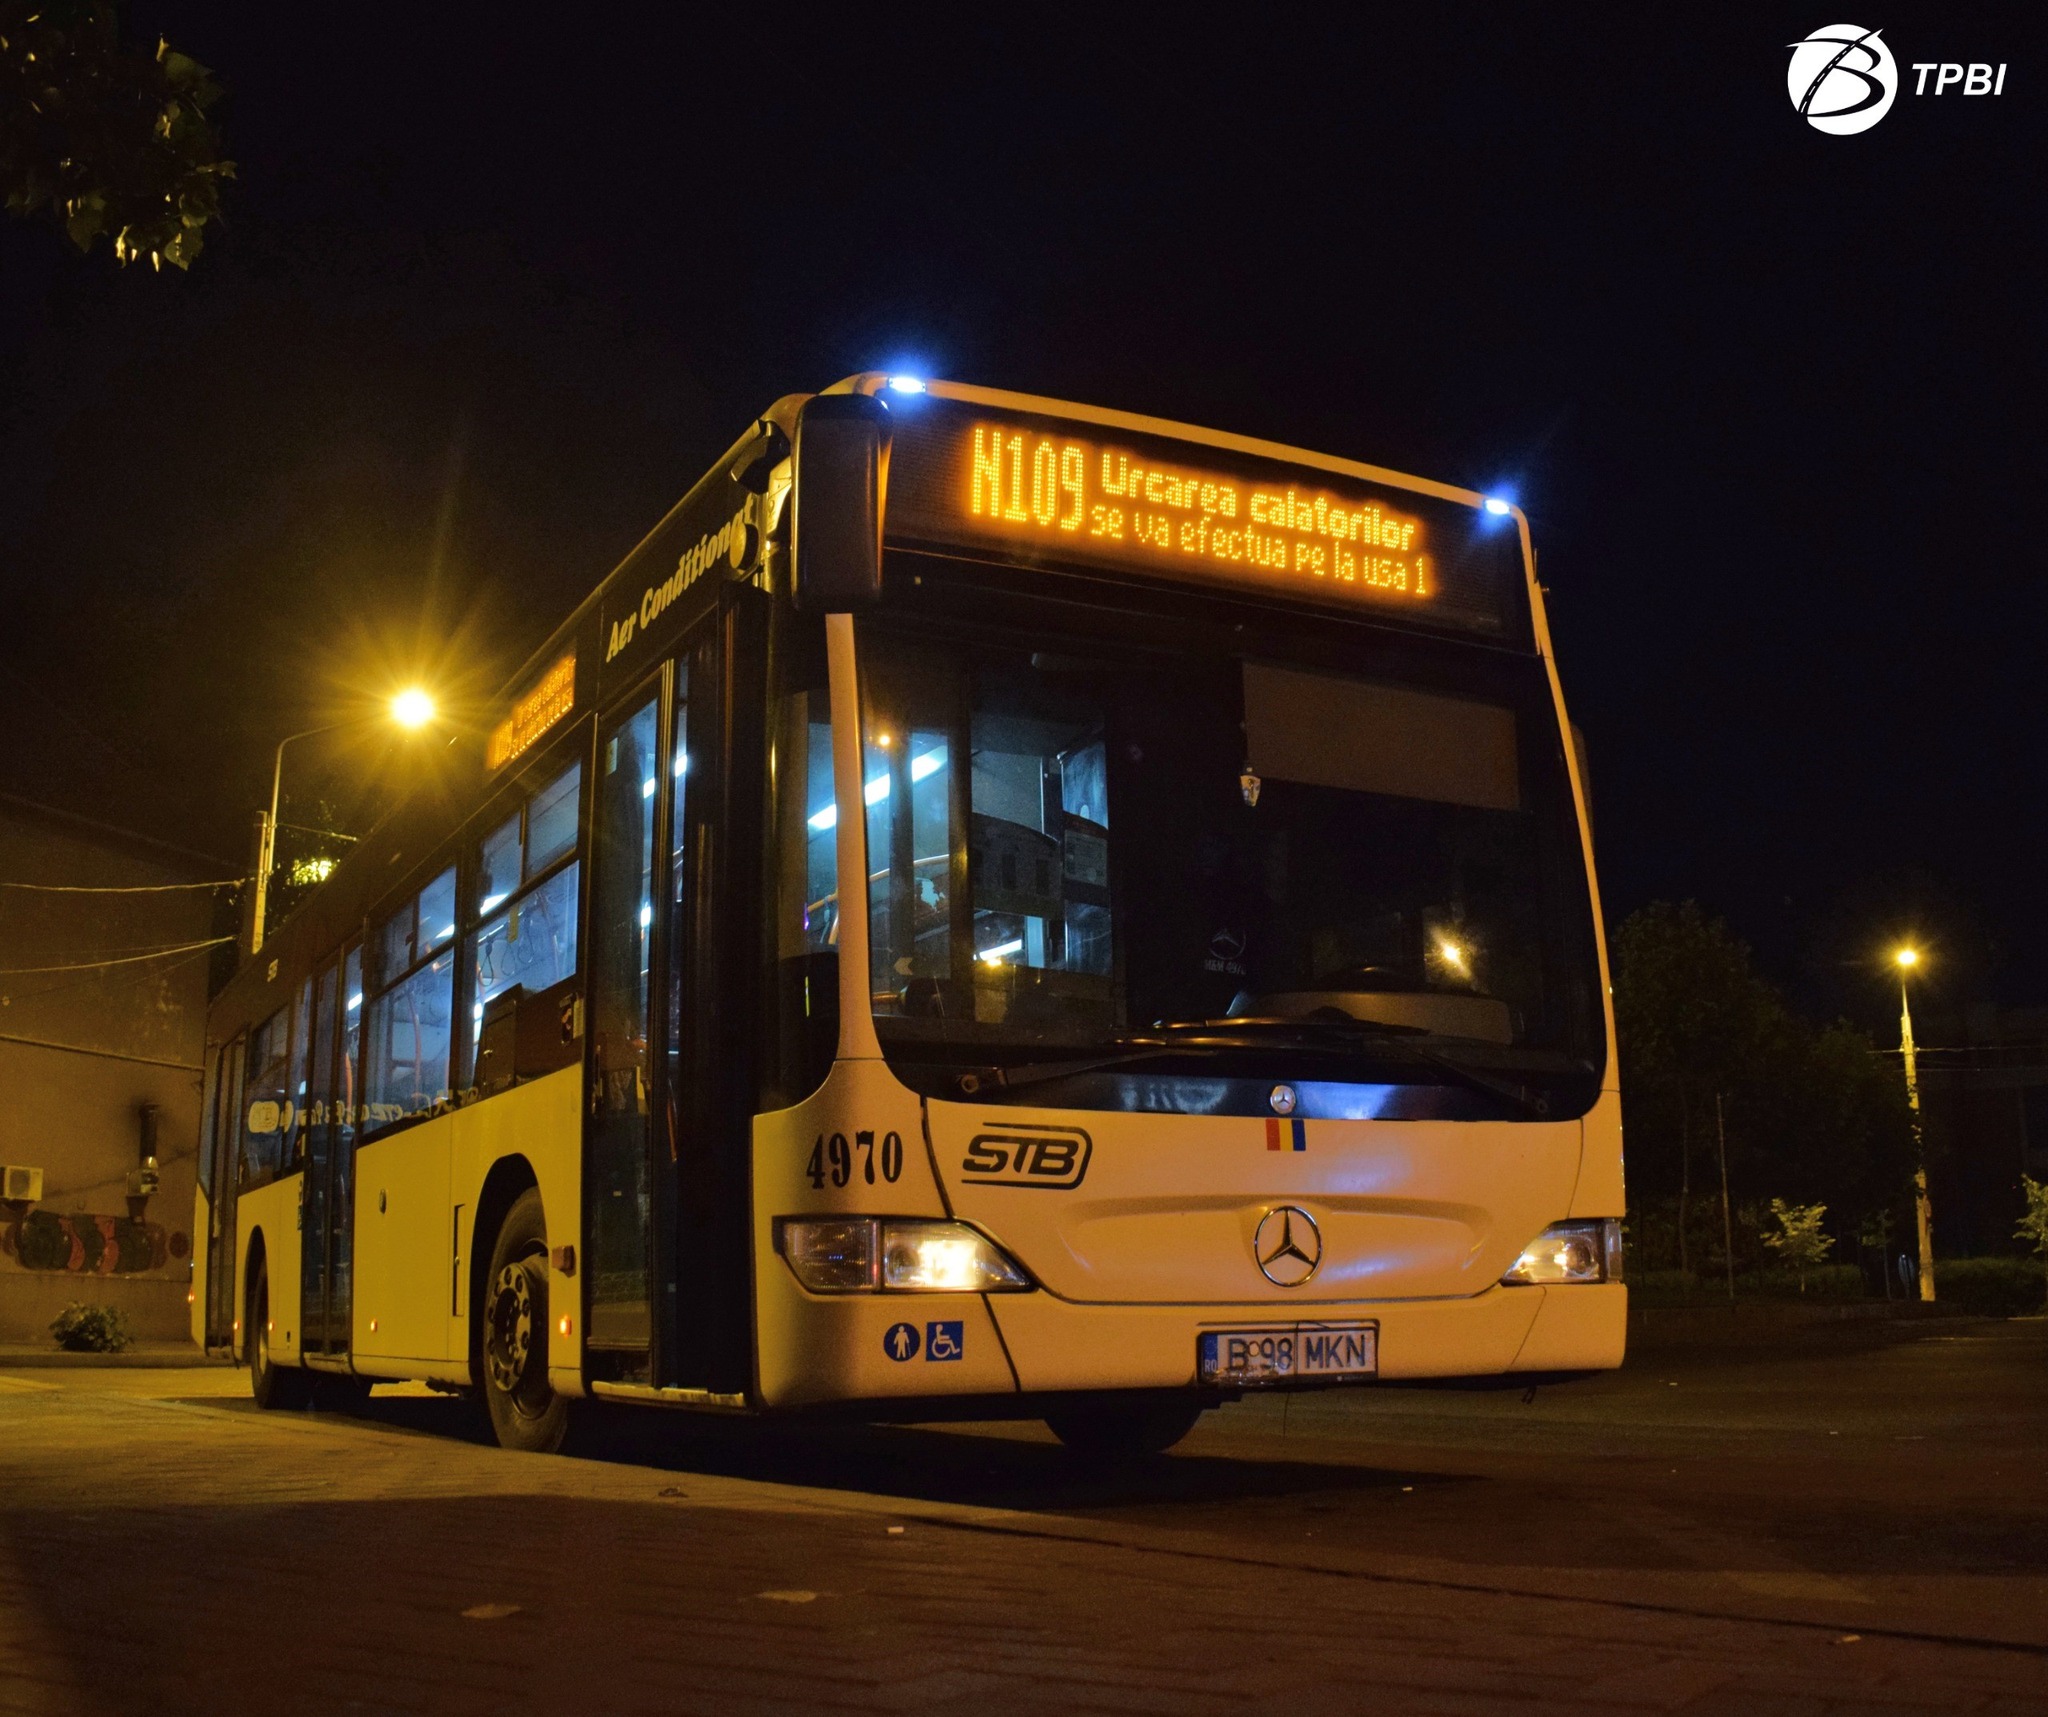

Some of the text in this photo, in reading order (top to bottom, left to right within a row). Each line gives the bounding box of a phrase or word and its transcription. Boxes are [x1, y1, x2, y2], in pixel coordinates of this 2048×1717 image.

[972, 427, 1083, 532] N109
[1101, 453, 1416, 551] Urcarea calatorilor
[1090, 504, 1427, 594] se va efectua pe la usa 1
[606, 612, 637, 664] Aer
[806, 1130, 904, 1190] 4970
[962, 1133, 1081, 1177] STB
[1205, 1359, 1218, 1373] RO
[1228, 1334, 1366, 1370] B 98 MKN
